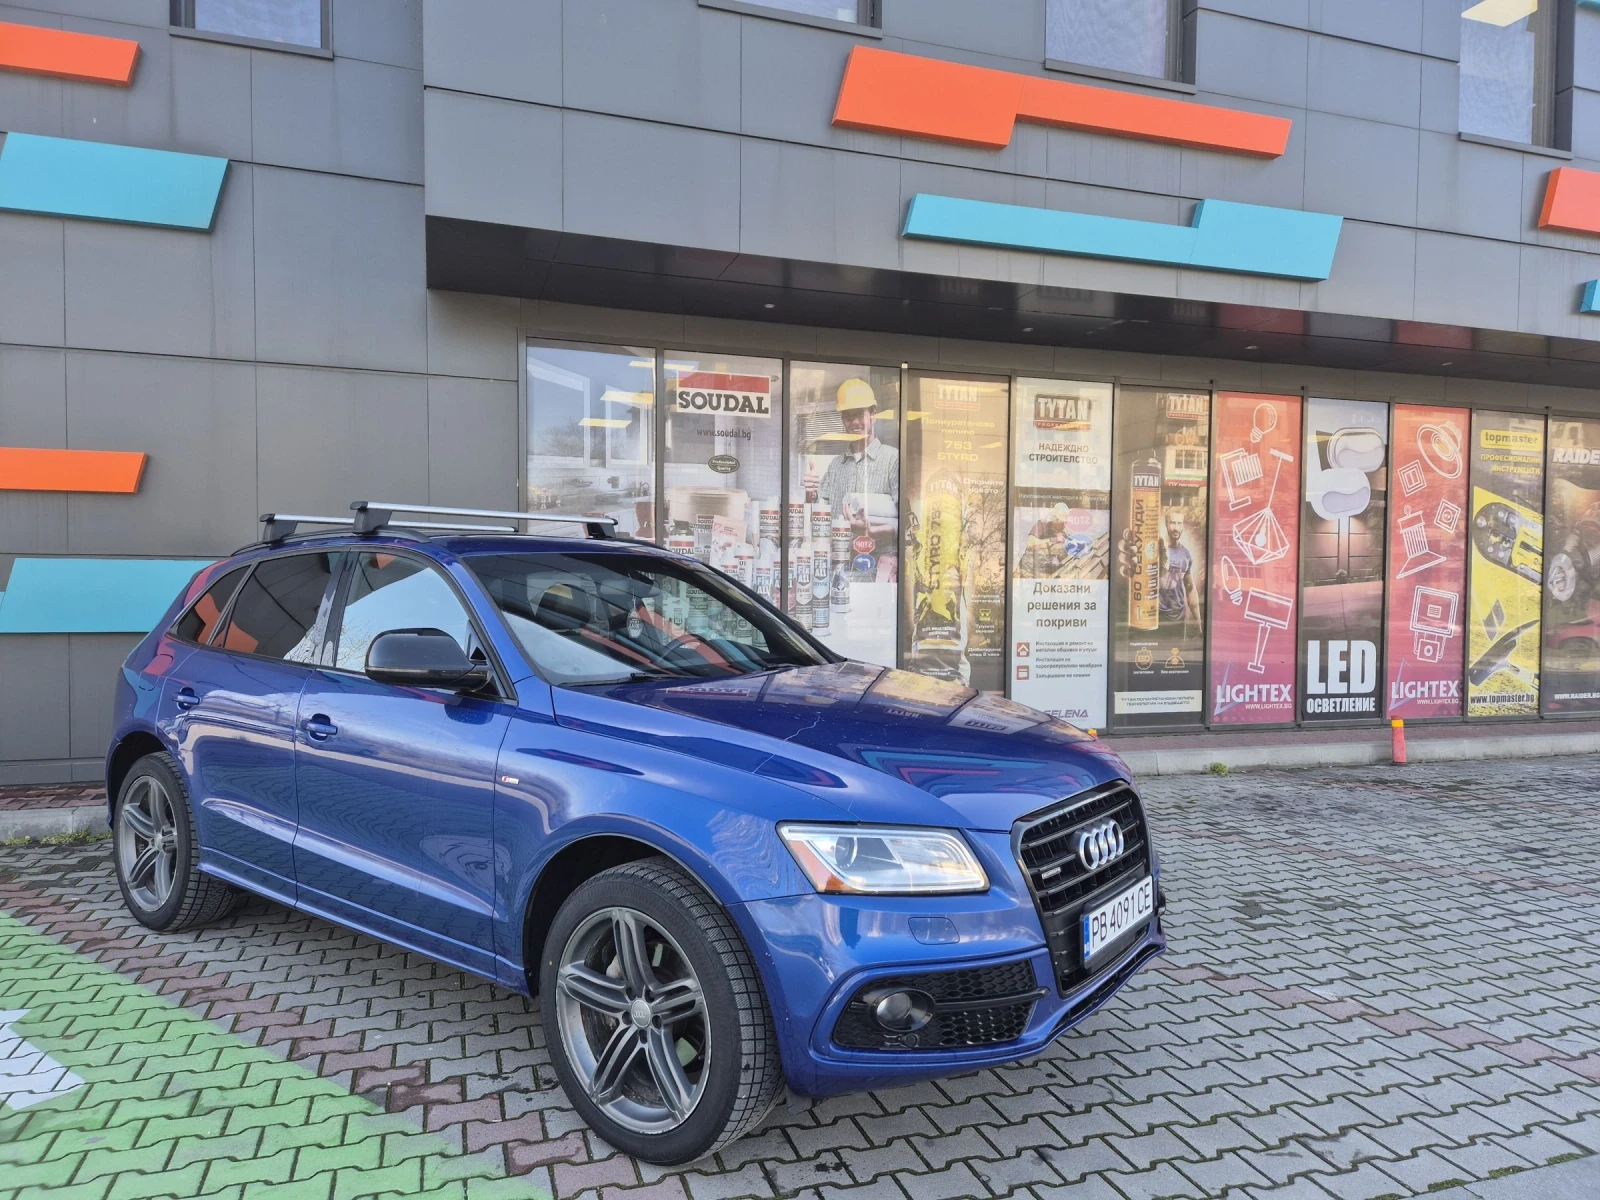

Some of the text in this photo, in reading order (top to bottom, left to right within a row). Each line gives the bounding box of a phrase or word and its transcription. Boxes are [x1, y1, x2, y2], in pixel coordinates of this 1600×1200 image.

[937, 384, 978, 402] TYTAN
[678, 390, 769, 414] SOUDAL
[1037, 398, 1088, 419] TYTAN
[697, 427, 751, 441] www.soudal.bg
[1485, 432, 1538, 444] topmaster
[943, 440, 973, 450] 753
[1038, 443, 1089, 453] НАДЕЖДНО
[937, 452, 978, 462] STYRO
[1028, 453, 1098, 465] СТРОИТЕЛСТВО
[1480, 453, 1541, 464] ПРОФЕСИОНАЛНИ
[1552, 446, 1600, 466] RAIDE
[1491, 465, 1541, 475] ИНСТРУМЕНТИ
[1133, 475, 1160, 487] TYTAN
[797, 565, 810, 574] FIX
[814, 559, 827, 569] FIX
[798, 573, 810, 583] ALL
[814, 568, 827, 577] ALL
[1033, 581, 1091, 595] Доказани
[1133, 581, 1142, 601] 60
[1027, 600, 1097, 613] решения за
[1036, 618, 1087, 630] покриви
[1306, 639, 1377, 695] LED
[1216, 684, 1292, 703] LIGHTEX
[1391, 680, 1459, 699] LIGHTEX
[1470, 692, 1535, 704] www.topmaster.bg
[1306, 697, 1376, 713] ОСВЕТЛЕНИЕ
[1092, 882, 1151, 949] PB 4091 CE
